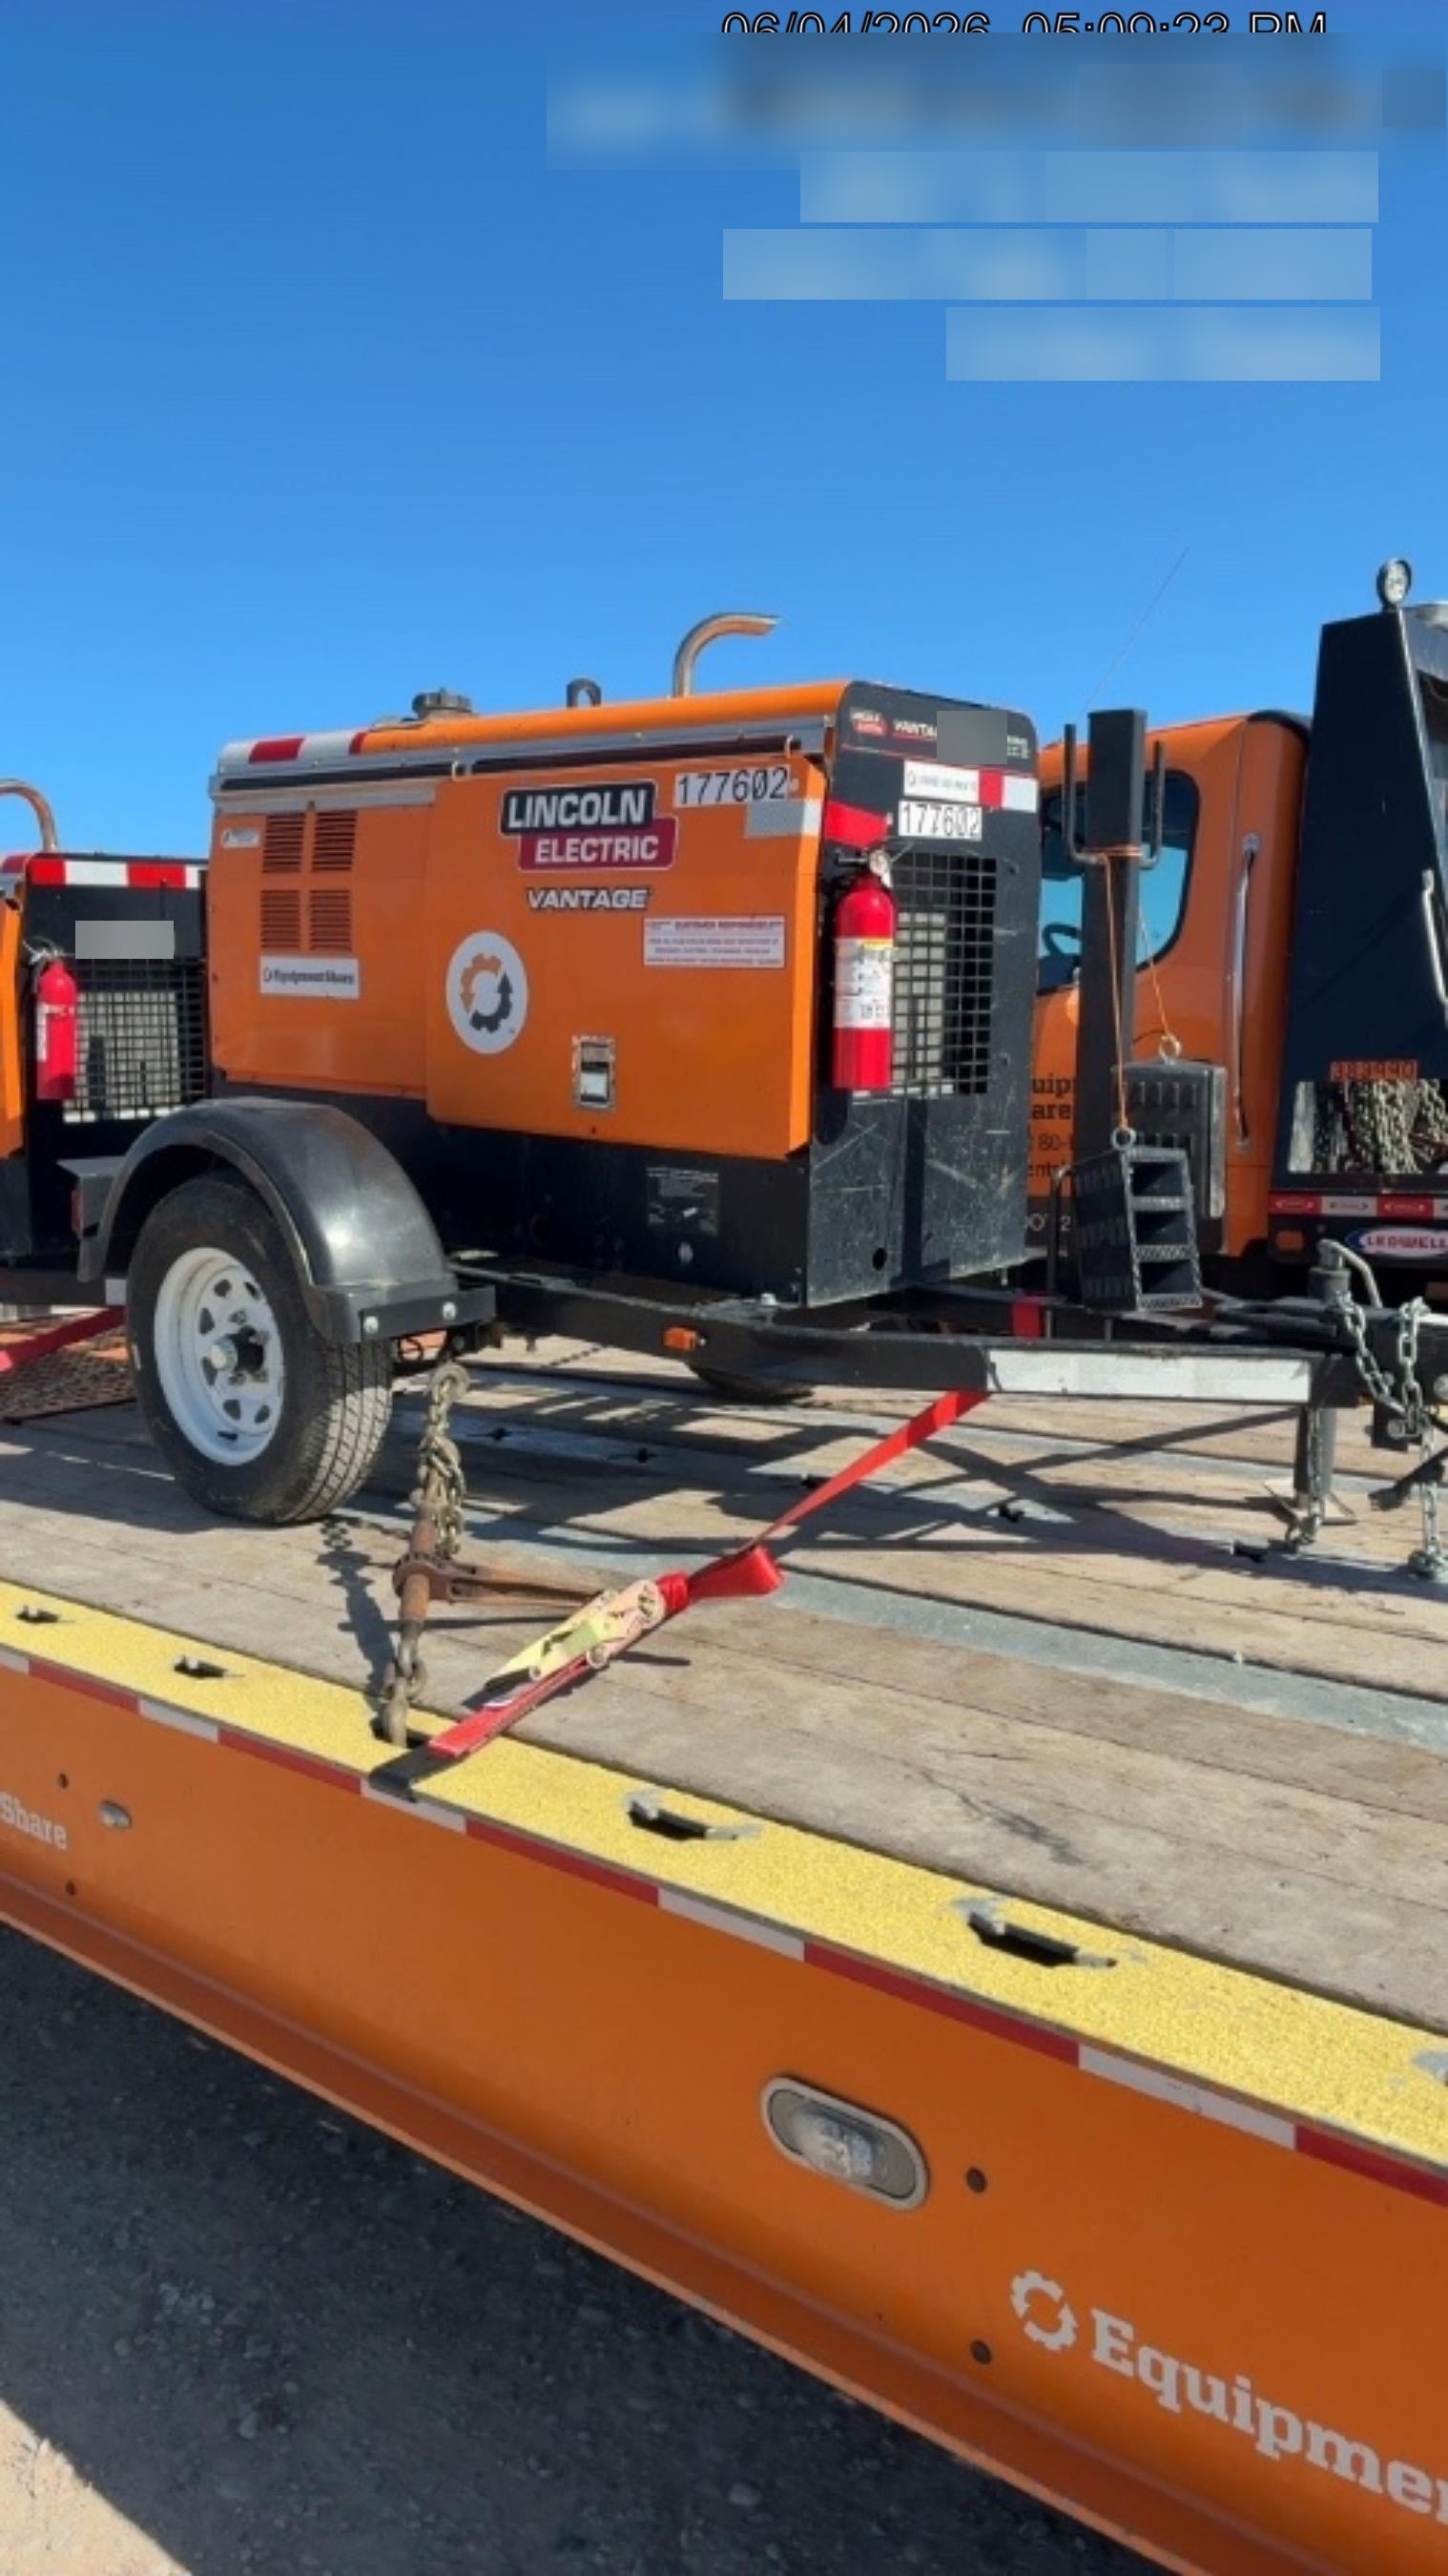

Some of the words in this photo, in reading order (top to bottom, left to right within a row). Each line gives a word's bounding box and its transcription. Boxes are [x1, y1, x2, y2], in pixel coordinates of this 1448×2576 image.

[679, 767, 788, 803] 177602
[507, 790, 648, 829] LINCOLN
[903, 802, 979, 837] 177602
[535, 835, 659, 864] ELECTRIC
[527, 887, 649, 909] VANTAGE
[1032, 1074, 1075, 1098] uip
[1031, 1104, 1071, 1120] are
[1091, 2307, 1448, 2526] Equipme
